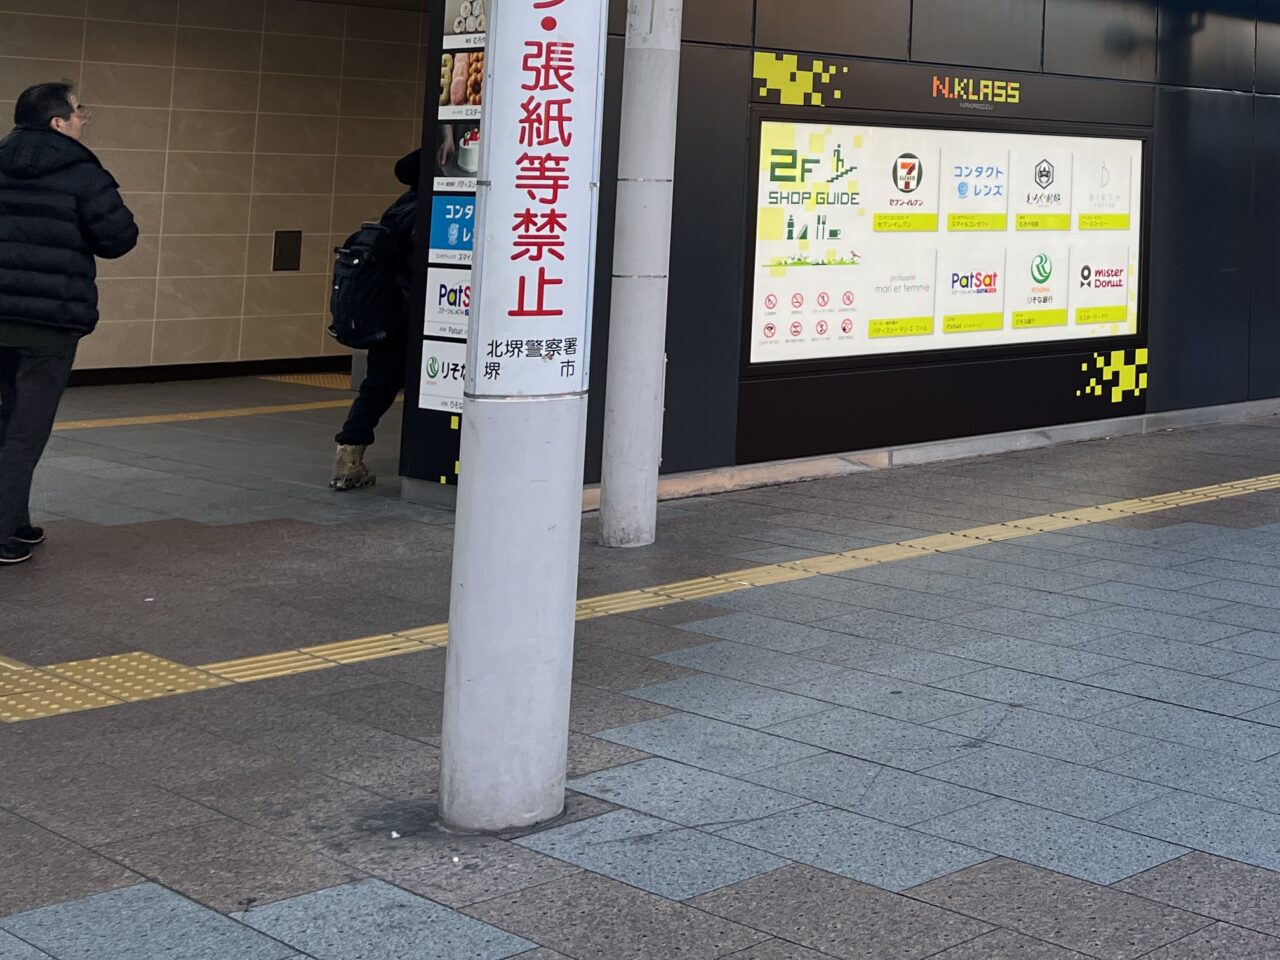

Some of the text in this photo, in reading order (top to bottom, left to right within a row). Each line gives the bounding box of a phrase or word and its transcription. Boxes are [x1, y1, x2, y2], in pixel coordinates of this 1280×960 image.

[932, 76, 1020, 103] N.KLASS
[770, 148, 820, 183] 2F
[954, 166, 1004, 178] コンタクト
[974, 184, 1003, 196] レンズ
[768, 191, 860, 205] SHOP GUIDE
[951, 271, 998, 289] PatSat
[1094, 269, 1124, 277] mister
[1094, 279, 1123, 288] Donut
[486, 337, 578, 359] 北堺警察署
